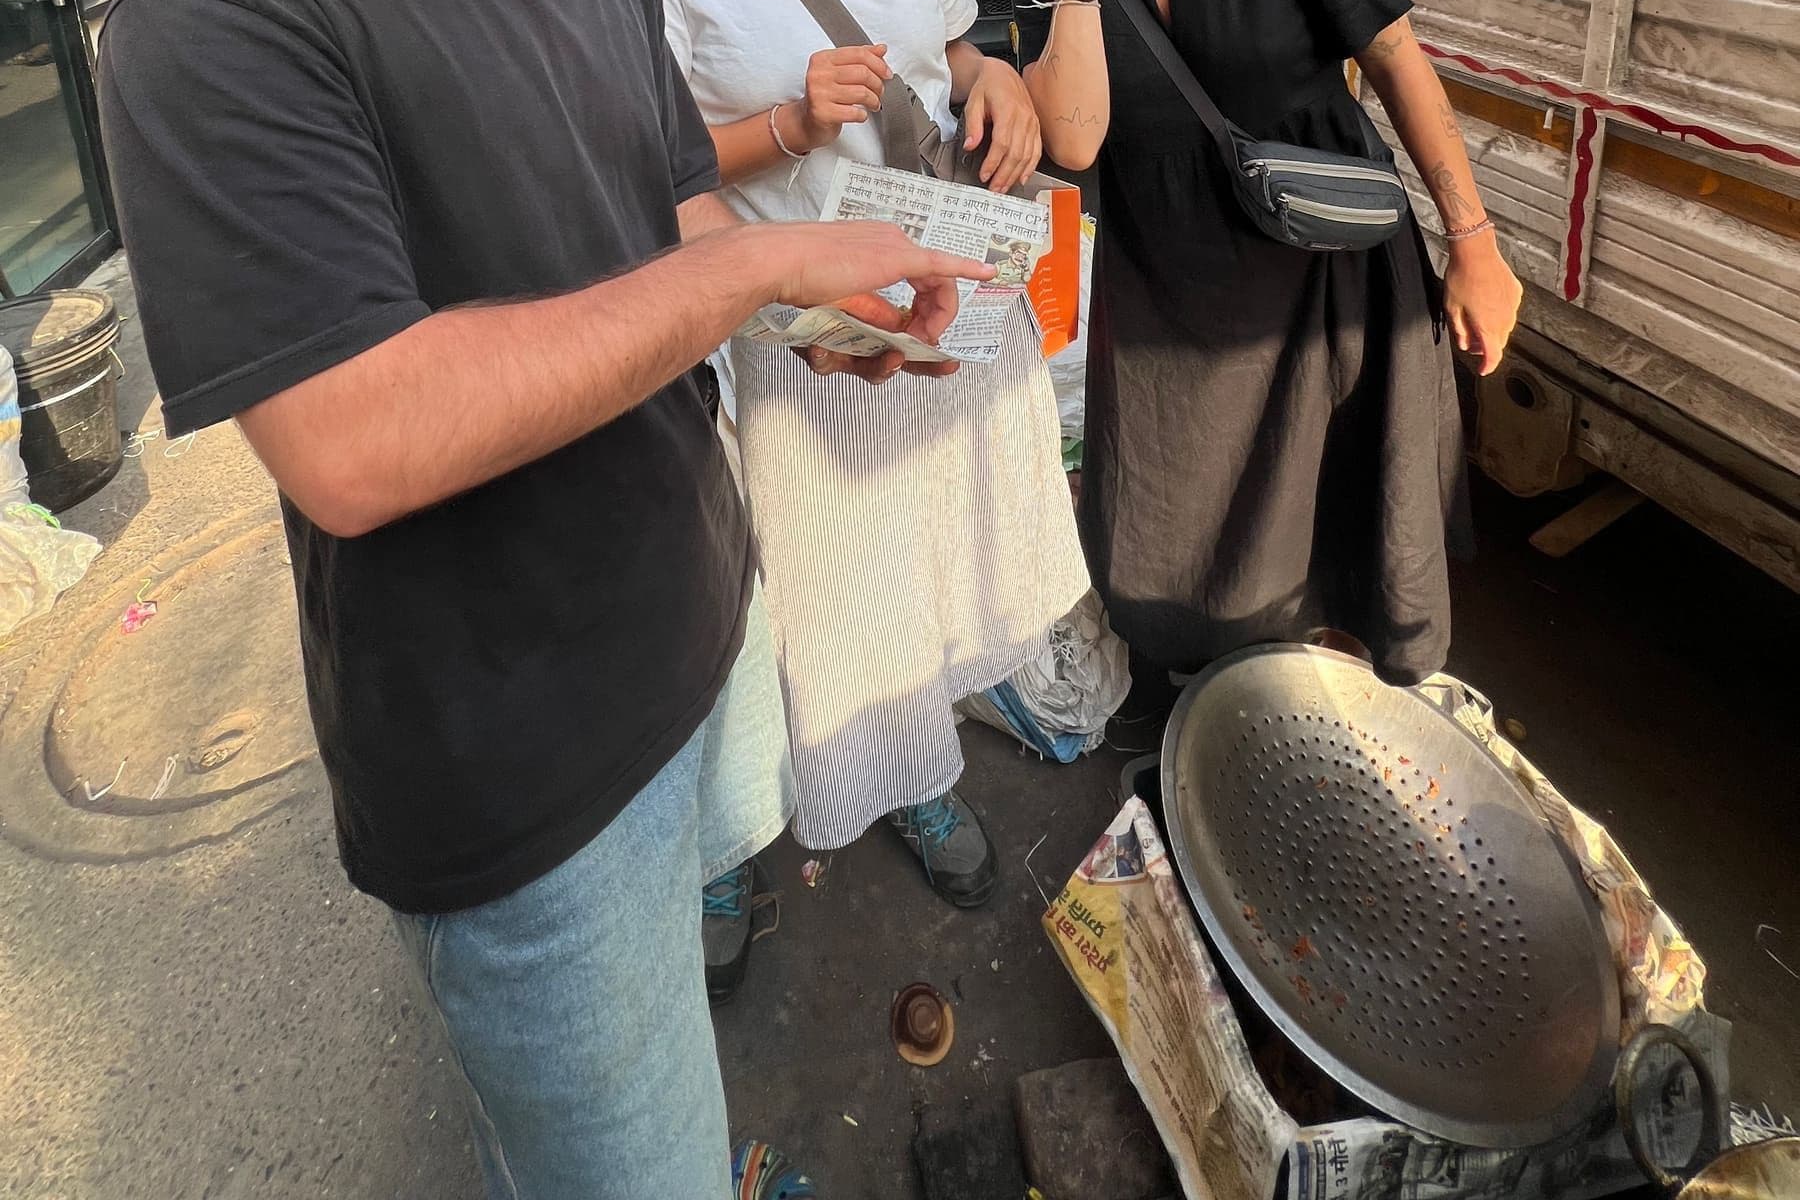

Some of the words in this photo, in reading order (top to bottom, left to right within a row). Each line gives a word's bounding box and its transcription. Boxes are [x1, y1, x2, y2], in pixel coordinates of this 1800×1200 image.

[940, 209, 957, 220] तक
[1004, 222, 1038, 239] लगातार
[943, 194, 960, 207] कब
[963, 198, 990, 213] आएगी
[992, 203, 1024, 221] स्पेशल
[1025, 213, 1042, 226] CP
[1335, 1176, 1348, 1188] 3
